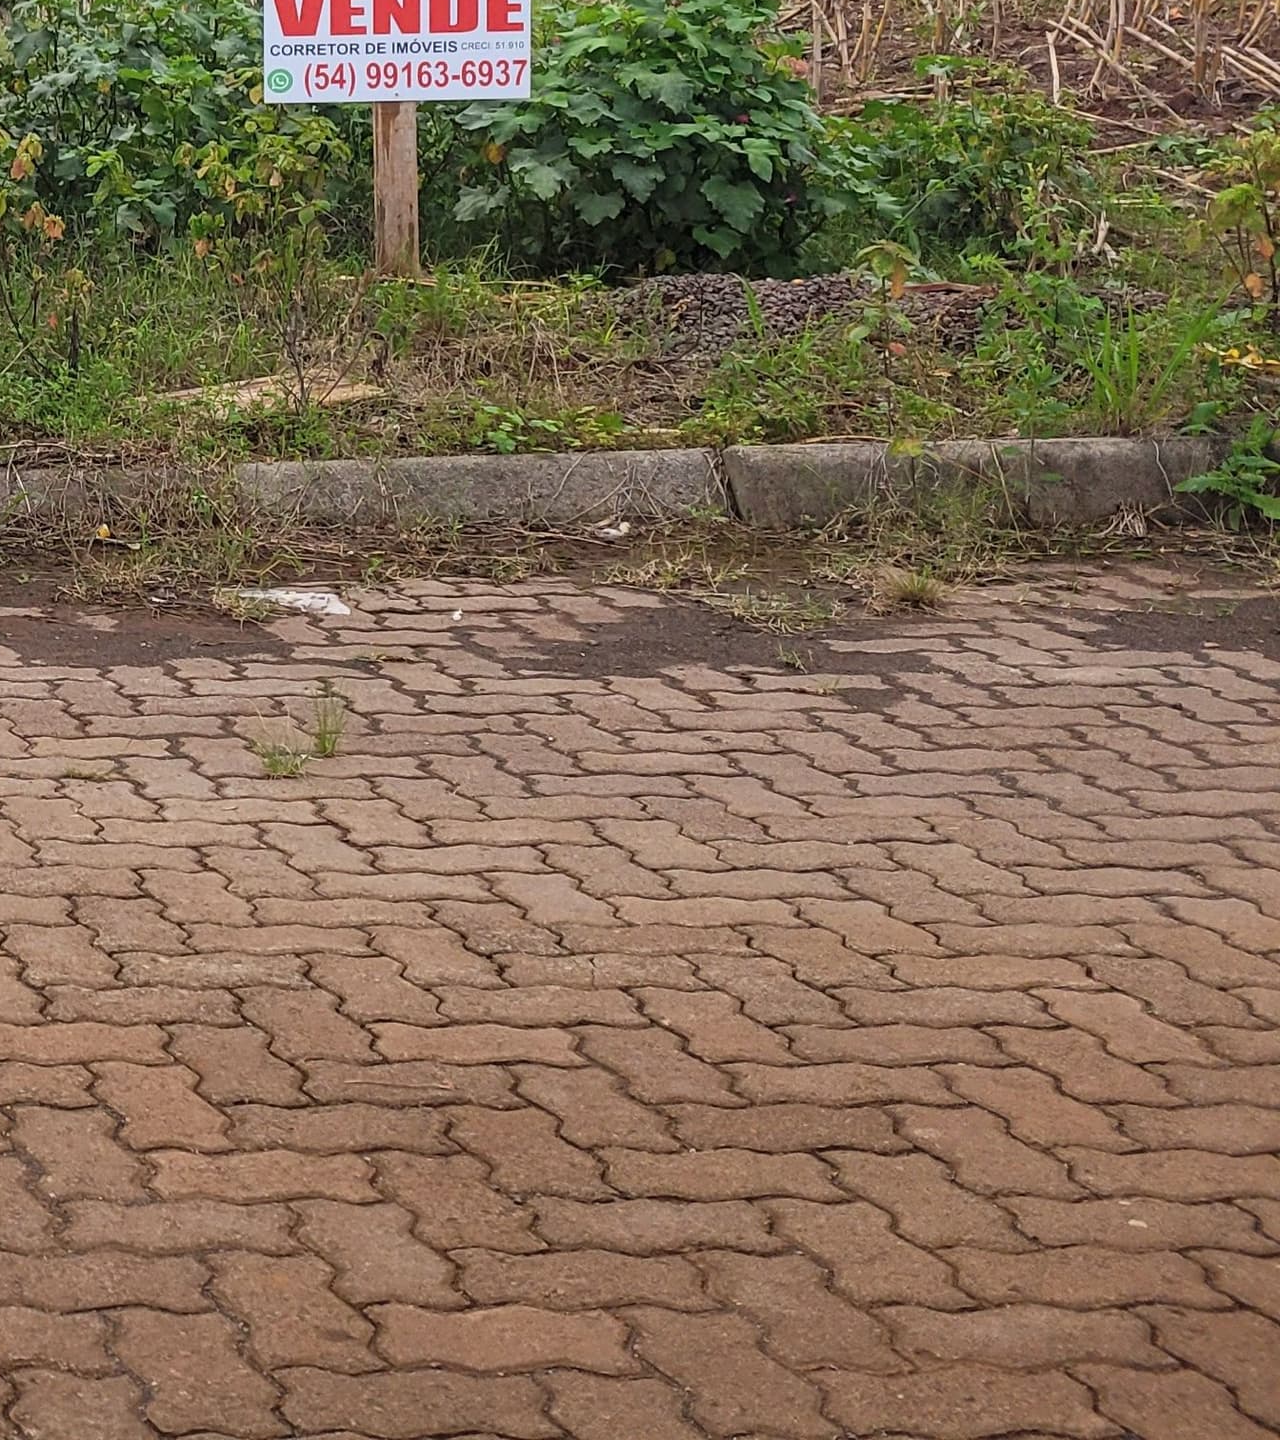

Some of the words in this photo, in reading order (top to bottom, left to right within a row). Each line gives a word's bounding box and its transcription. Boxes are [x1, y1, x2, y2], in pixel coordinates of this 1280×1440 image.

[270, 43, 360, 57] CORRETOR
[365, 42, 387, 54] DE
[391, 38, 458, 54] IMÓVEIS
[304, 62, 357, 97] (54)
[366, 59, 527, 90] 99163-6937
